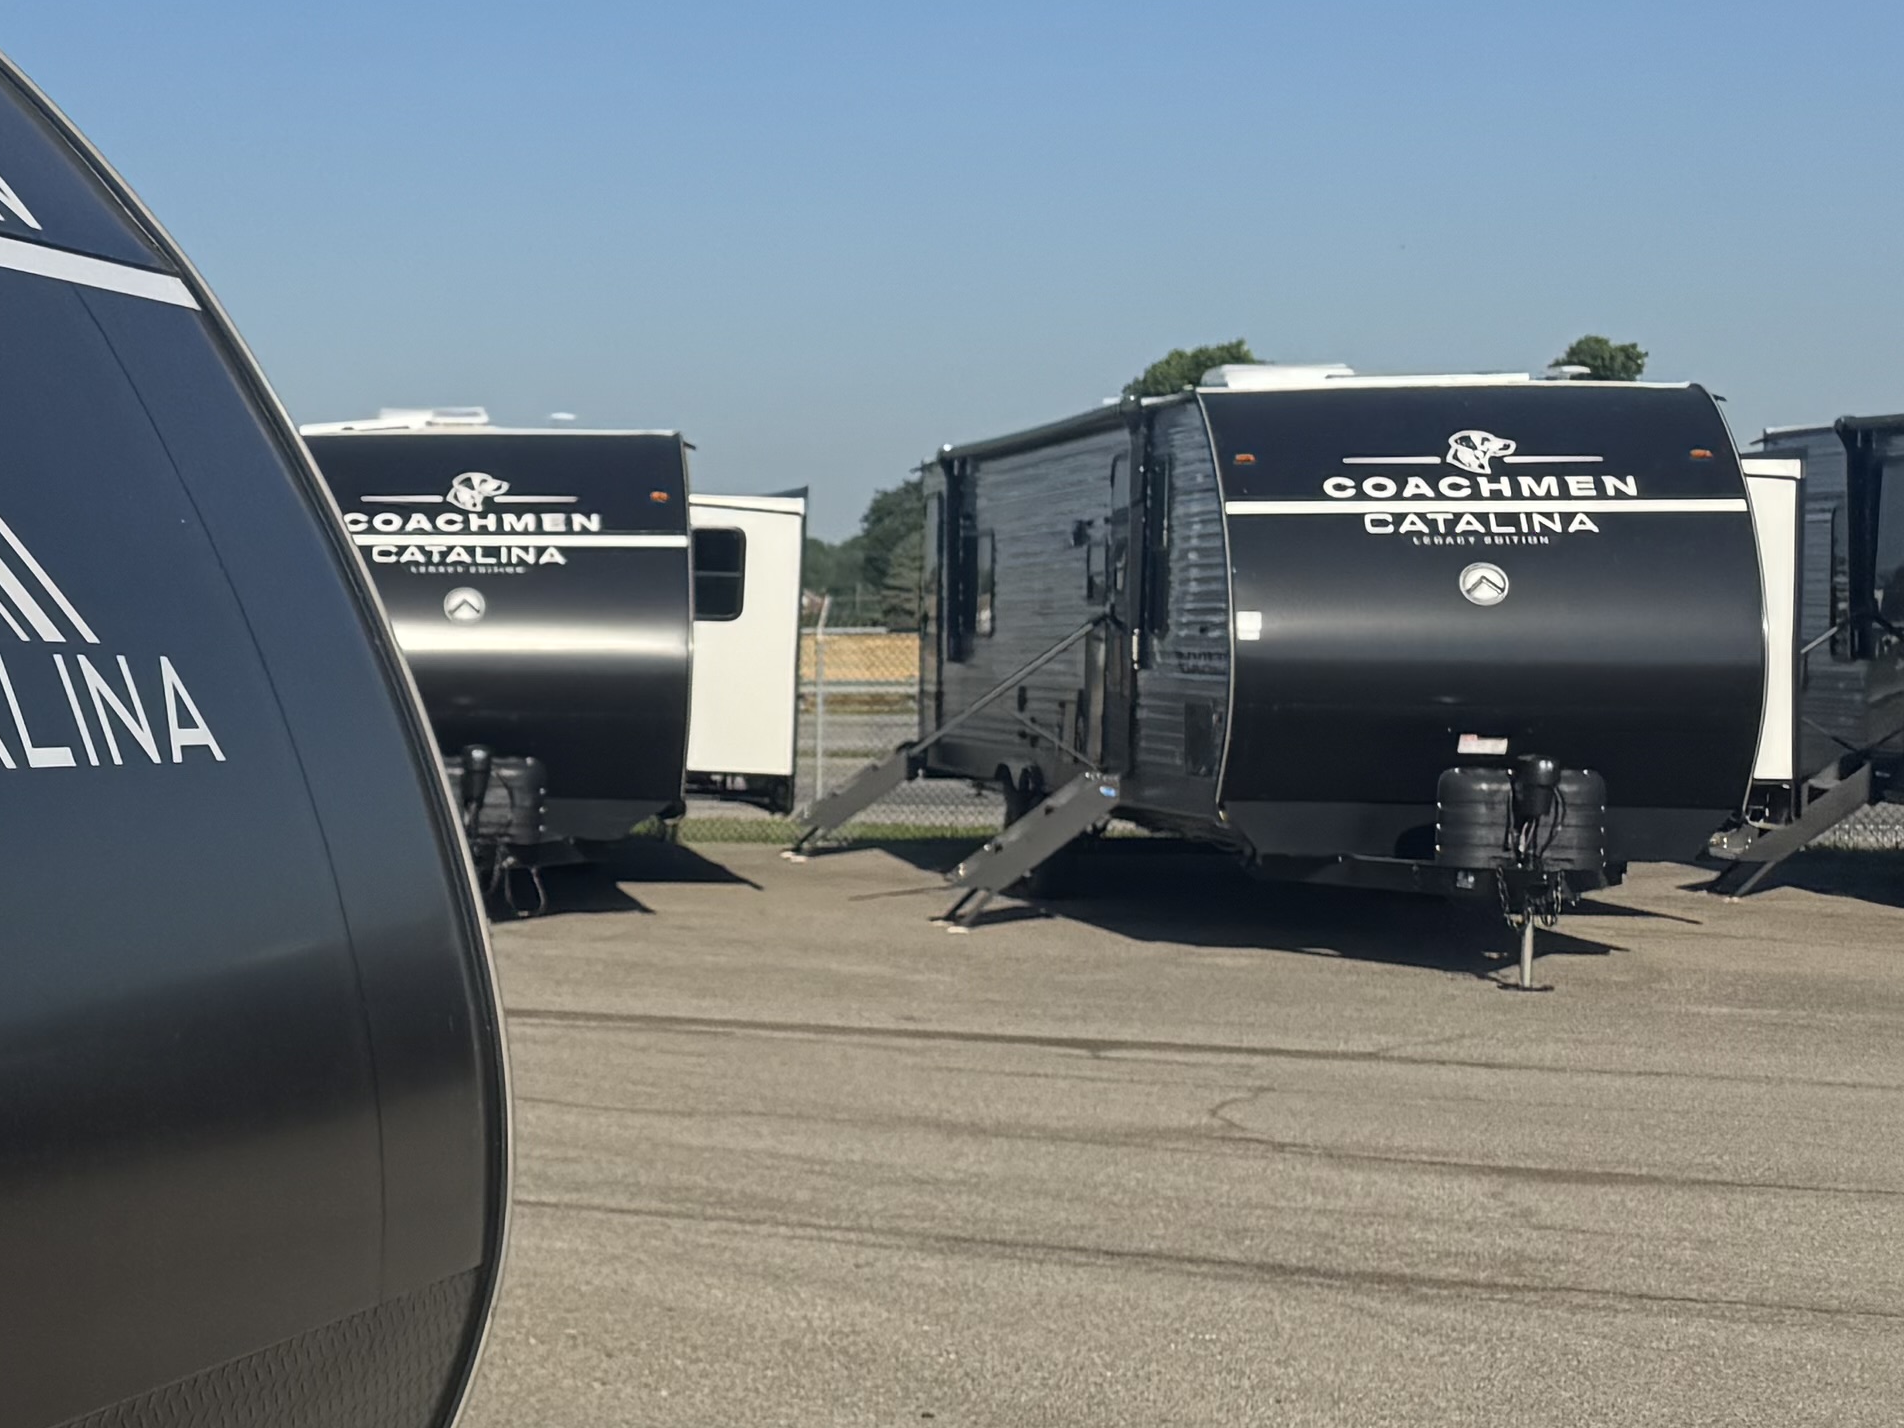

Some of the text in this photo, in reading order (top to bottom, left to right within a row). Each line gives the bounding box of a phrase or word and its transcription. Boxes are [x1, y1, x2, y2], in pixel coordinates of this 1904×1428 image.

[1323, 475, 1638, 498] COACHMEN
[343, 512, 602, 532] COACHMEN
[1364, 512, 1599, 534] CATALINA
[372, 545, 567, 564] CATALINA
